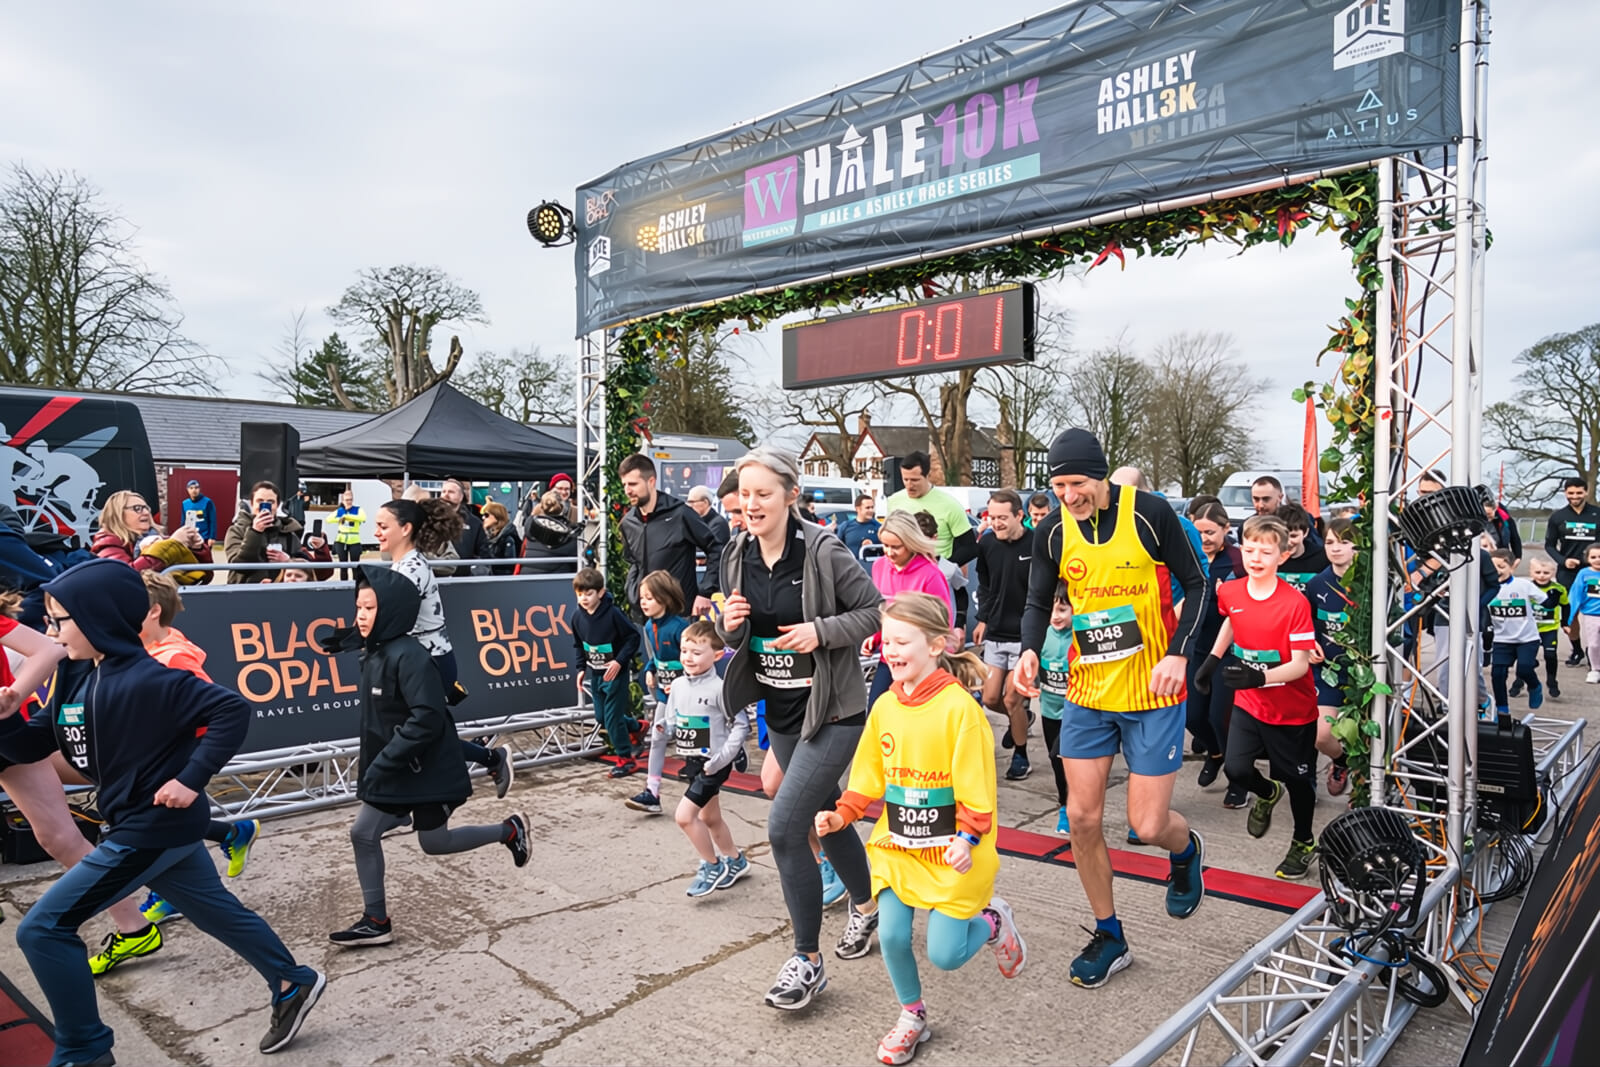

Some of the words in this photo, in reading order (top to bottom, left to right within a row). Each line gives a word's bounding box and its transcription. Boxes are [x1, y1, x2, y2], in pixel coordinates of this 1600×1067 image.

[1098, 50, 1196, 106] ASHLEY
[1326, 108, 1418, 141] ALTIUS
[750, 166, 794, 219] W
[820, 209, 849, 226] HALE
[853, 209, 862, 219] &
[866, 193, 914, 216] ASHLEY
[918, 179, 955, 202] RACE
[959, 164, 1013, 191] SERIES
[658, 202, 707, 234] ASHLEY
[898, 297, 1004, 366] 0:01
[1494, 607, 1523, 616] 3102
[471, 604, 573, 642] BLACK
[1325, 621, 1345, 631] 303
[231, 617, 349, 662] BLAC
[1086, 625, 1123, 643] 3048
[1097, 641, 1117, 652] ANDY
[479, 638, 568, 676] OPAL
[759, 654, 794, 668] 3050
[237, 656, 358, 702] OPAL
[488, 680, 529, 690] TRAVEL
[535, 674, 571, 684] GROUP
[765, 668, 792, 678] SANDRA
[256, 706, 304, 718] RAVEL
[312, 699, 360, 711] GROUP
[676, 729, 697, 739] 079
[898, 806, 939, 824] 3049
[903, 825, 931, 836] MABEL
